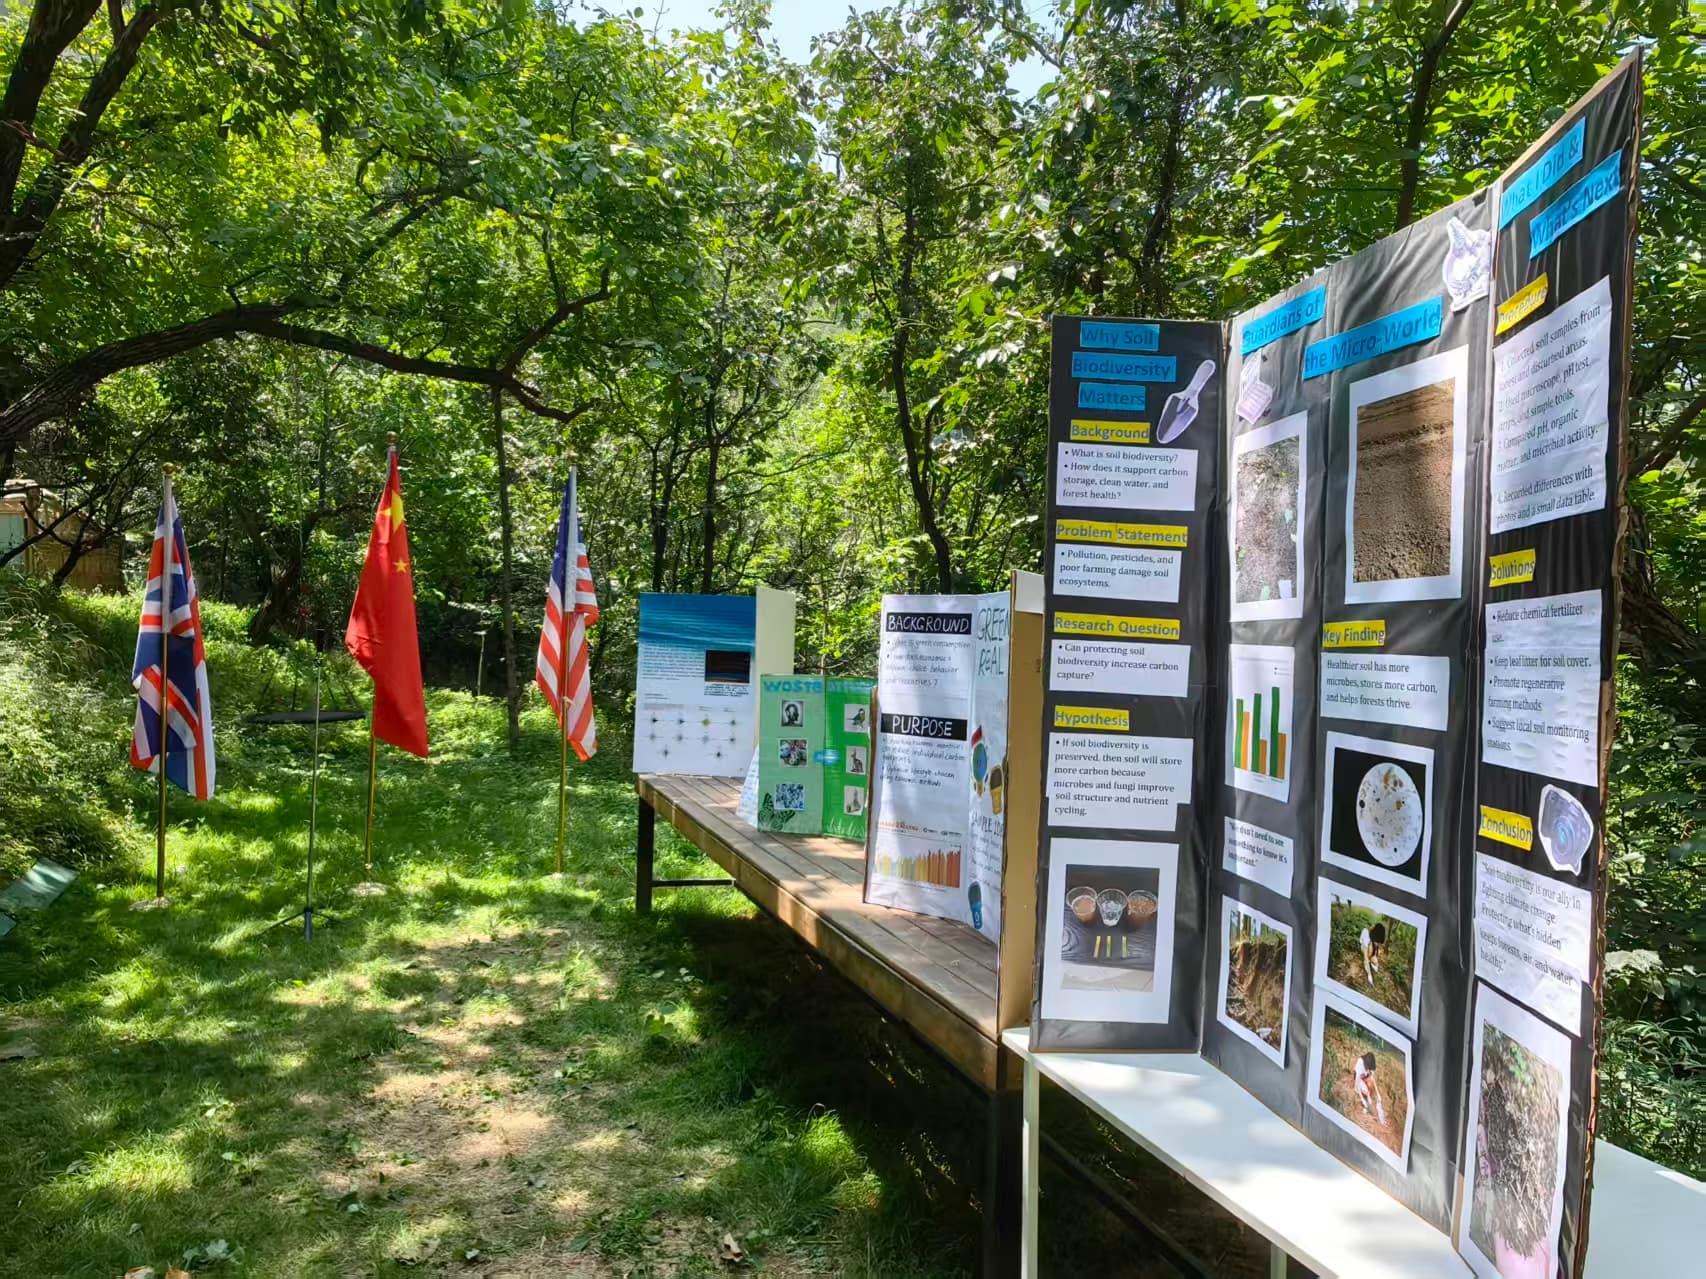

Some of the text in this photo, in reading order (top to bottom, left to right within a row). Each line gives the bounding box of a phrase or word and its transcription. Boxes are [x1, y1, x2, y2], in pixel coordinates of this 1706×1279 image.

[1535, 170, 1539, 190] I
[1543, 152, 1564, 185] Did
[1568, 134, 1580, 160] &
[1533, 166, 1620, 249] What's Next
[1242, 294, 1321, 346] Guardians of
[1536, 304, 1600, 351] soil samples from
[1082, 326, 1154, 348] Why Soil
[1305, 304, 1441, 372] the Micro-World
[1073, 357, 1171, 379] Biodiversity
[1563, 365, 1574, 383] pH
[1079, 387, 1145, 407] Matters
[1530, 398, 1554, 418] simple
[1551, 408, 1580, 430] organic
[1071, 424, 1150, 441] Background
[1532, 434, 1566, 458] microbial
[1071, 449, 1178, 464] What is soil biodiversity?
[1070, 462, 1189, 478] How does it support carbon
[1533, 472, 1574, 494] differences
[1575, 463, 1593, 482] with
[1063, 477, 1097, 488] storage,
[1099, 478, 1122, 488] clean
[1152, 479, 1169, 489] and
[1063, 488, 1121, 501] forest health?
[1518, 504, 1532, 520] and
[1537, 498, 1556, 514] small
[1556, 494, 1573, 510] data
[1056, 524, 1188, 544] Problem Statement
[1067, 550, 1173, 565] Pollution, pesticides, and
[1060, 564, 1169, 578] poor farming damage soil
[1491, 559, 1535, 580] Solutions
[1059, 579, 1110, 589] ecosystems.
[1497, 602, 1584, 622] Reduce chemical fertilizer
[887, 615, 970, 633] BACKGROUND
[977, 608, 1010, 642] GREEN
[1055, 617, 1180, 638] Research Question
[1323, 627, 1385, 644] Key Finding
[1064, 643, 1145, 656] Can protecting soil
[978, 646, 1005, 676] REAL
[1057, 657, 1179, 671] biodiversity increase carbon
[1327, 659, 1410, 673] Healthier soil has more
[1494, 656, 1508, 669] Keep
[1509, 656, 1520, 667] leaf
[1540, 656, 1551, 667] for
[1553, 656, 1565, 667] soil
[1566, 657, 1592, 668] cover.
[1056, 671, 1094, 681] capture?
[1493, 676, 1565, 692] Promote regenerative
[1327, 677, 1438, 694] microbes, stores more carbon,
[1326, 694, 1385, 707] and helps forests
[892, 715, 953, 737] PURPOSE
[1055, 710, 1129, 727] Hypothesis
[1492, 716, 1590, 744] Suggest local soil monitoring
[1062, 738, 1150, 752] If soil biodiversity is
[1102, 753, 1182, 766] then soil will store
[1054, 766, 1146, 778] more carbon because
[1053, 780, 1175, 794] microbes and fungi improve
[1055, 792, 1168, 806] soil structure and nutrient
[1055, 806, 1087, 816] cycling.
[1481, 813, 1533, 842] Conclusion
[1254, 832, 1268, 842] need
[1275, 839, 1284, 847] see
[1262, 848, 1277, 860] know
[1505, 891, 1529, 913] climate
[1535, 884, 1541, 895] is
[1557, 886, 1571, 909] ally
[1481, 902, 1562, 950] Protecting what's hidden
[1535, 958, 1549, 975] and
[1549, 968, 1574, 987] water
